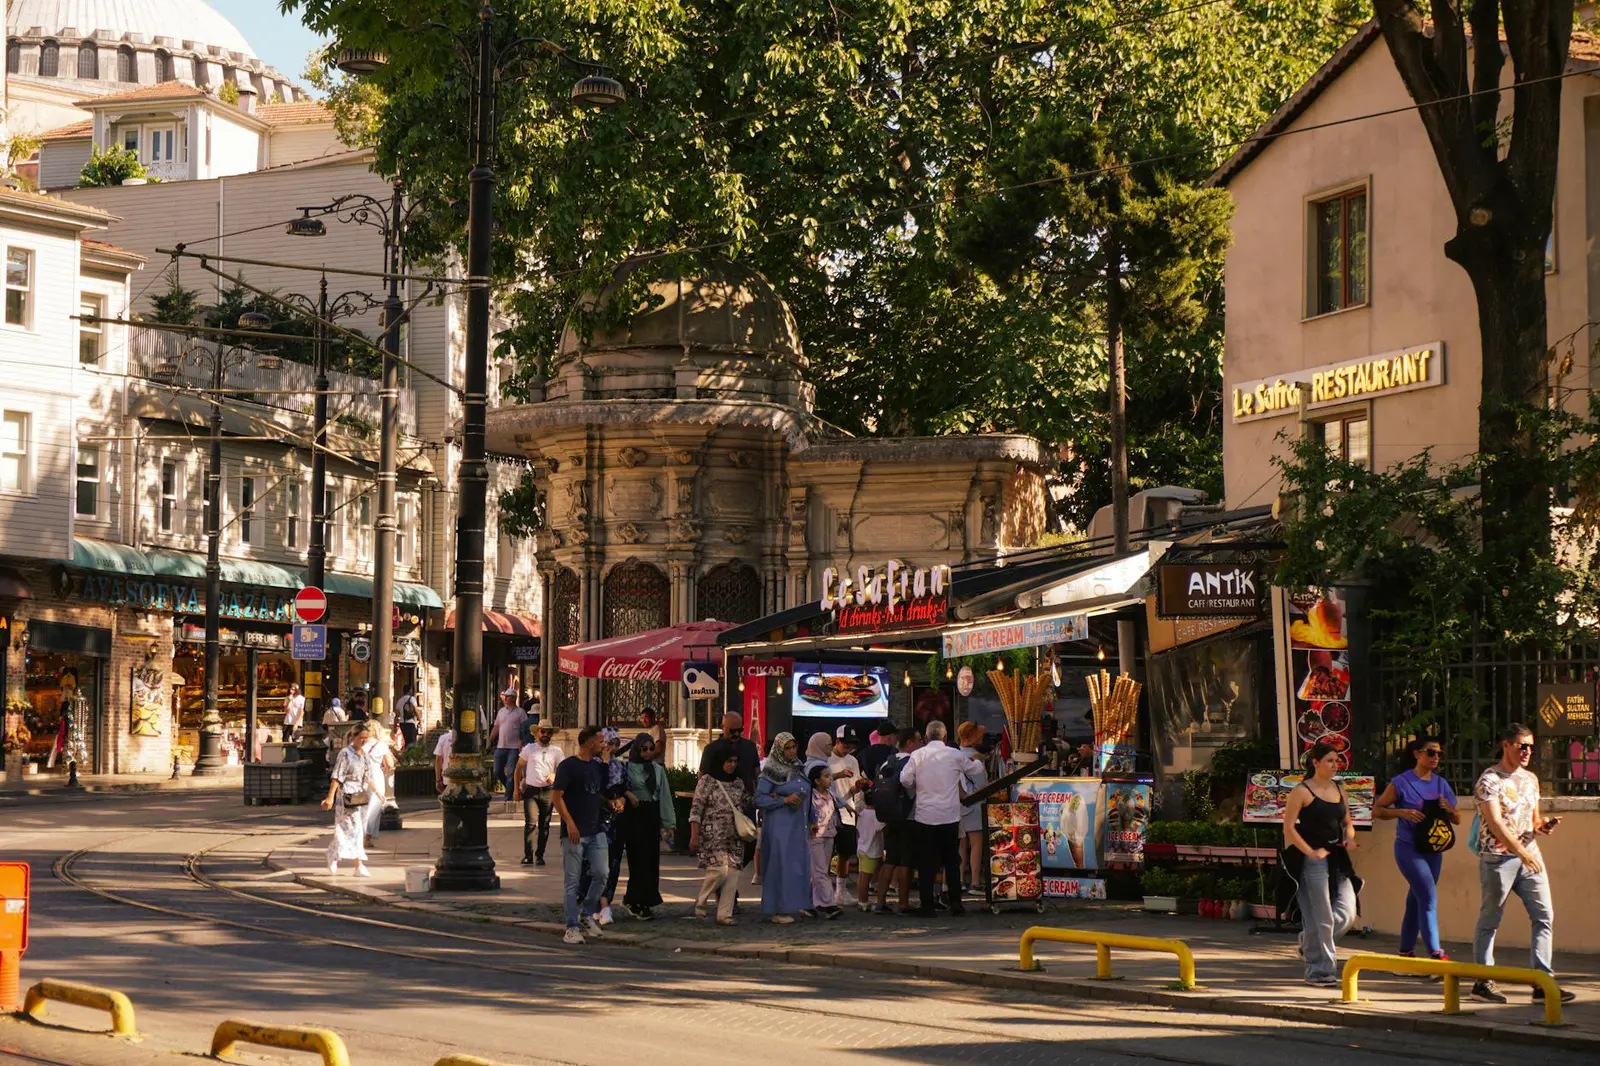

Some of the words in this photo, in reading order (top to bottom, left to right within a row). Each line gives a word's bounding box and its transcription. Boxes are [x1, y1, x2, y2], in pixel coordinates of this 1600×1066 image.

[1232, 388, 1254, 418] Le
[1255, 379, 1302, 414] Safra
[1312, 350, 1432, 404] RESTAURANT
[83, 575, 201, 613] AYASOFYA
[820, 566, 853, 612] Le
[856, 559, 951, 616] Safran
[247, 632, 279, 645] PERFUME
[966, 632, 984, 651] ICE
[985, 624, 1025, 649] CREAM
[598, 657, 667, 680] Coca-Cola
[1567, 704, 1590, 712] SULTAN
[1567, 712, 1593, 720] MEHMET
[1035, 792, 1048, 804] ICE
[1047, 792, 1073, 804] CREAM
[1109, 831, 1119, 841] ICE
[1120, 831, 1143, 841] CREAM
[1049, 880, 1079, 894] CREAM
